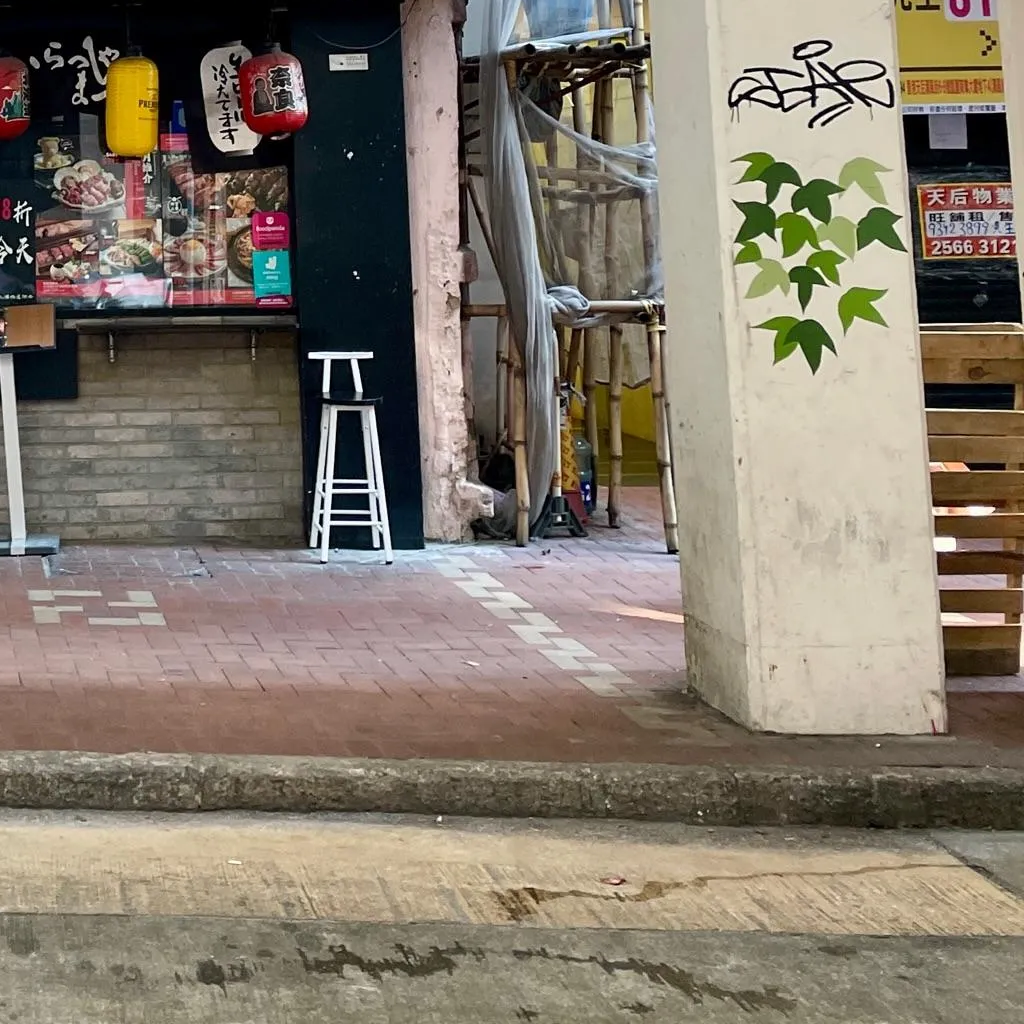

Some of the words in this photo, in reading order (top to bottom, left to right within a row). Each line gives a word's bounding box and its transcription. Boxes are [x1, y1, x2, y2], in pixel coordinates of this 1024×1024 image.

[927, 187, 1013, 206] 天后物業
[931, 240, 974, 256] 2566
